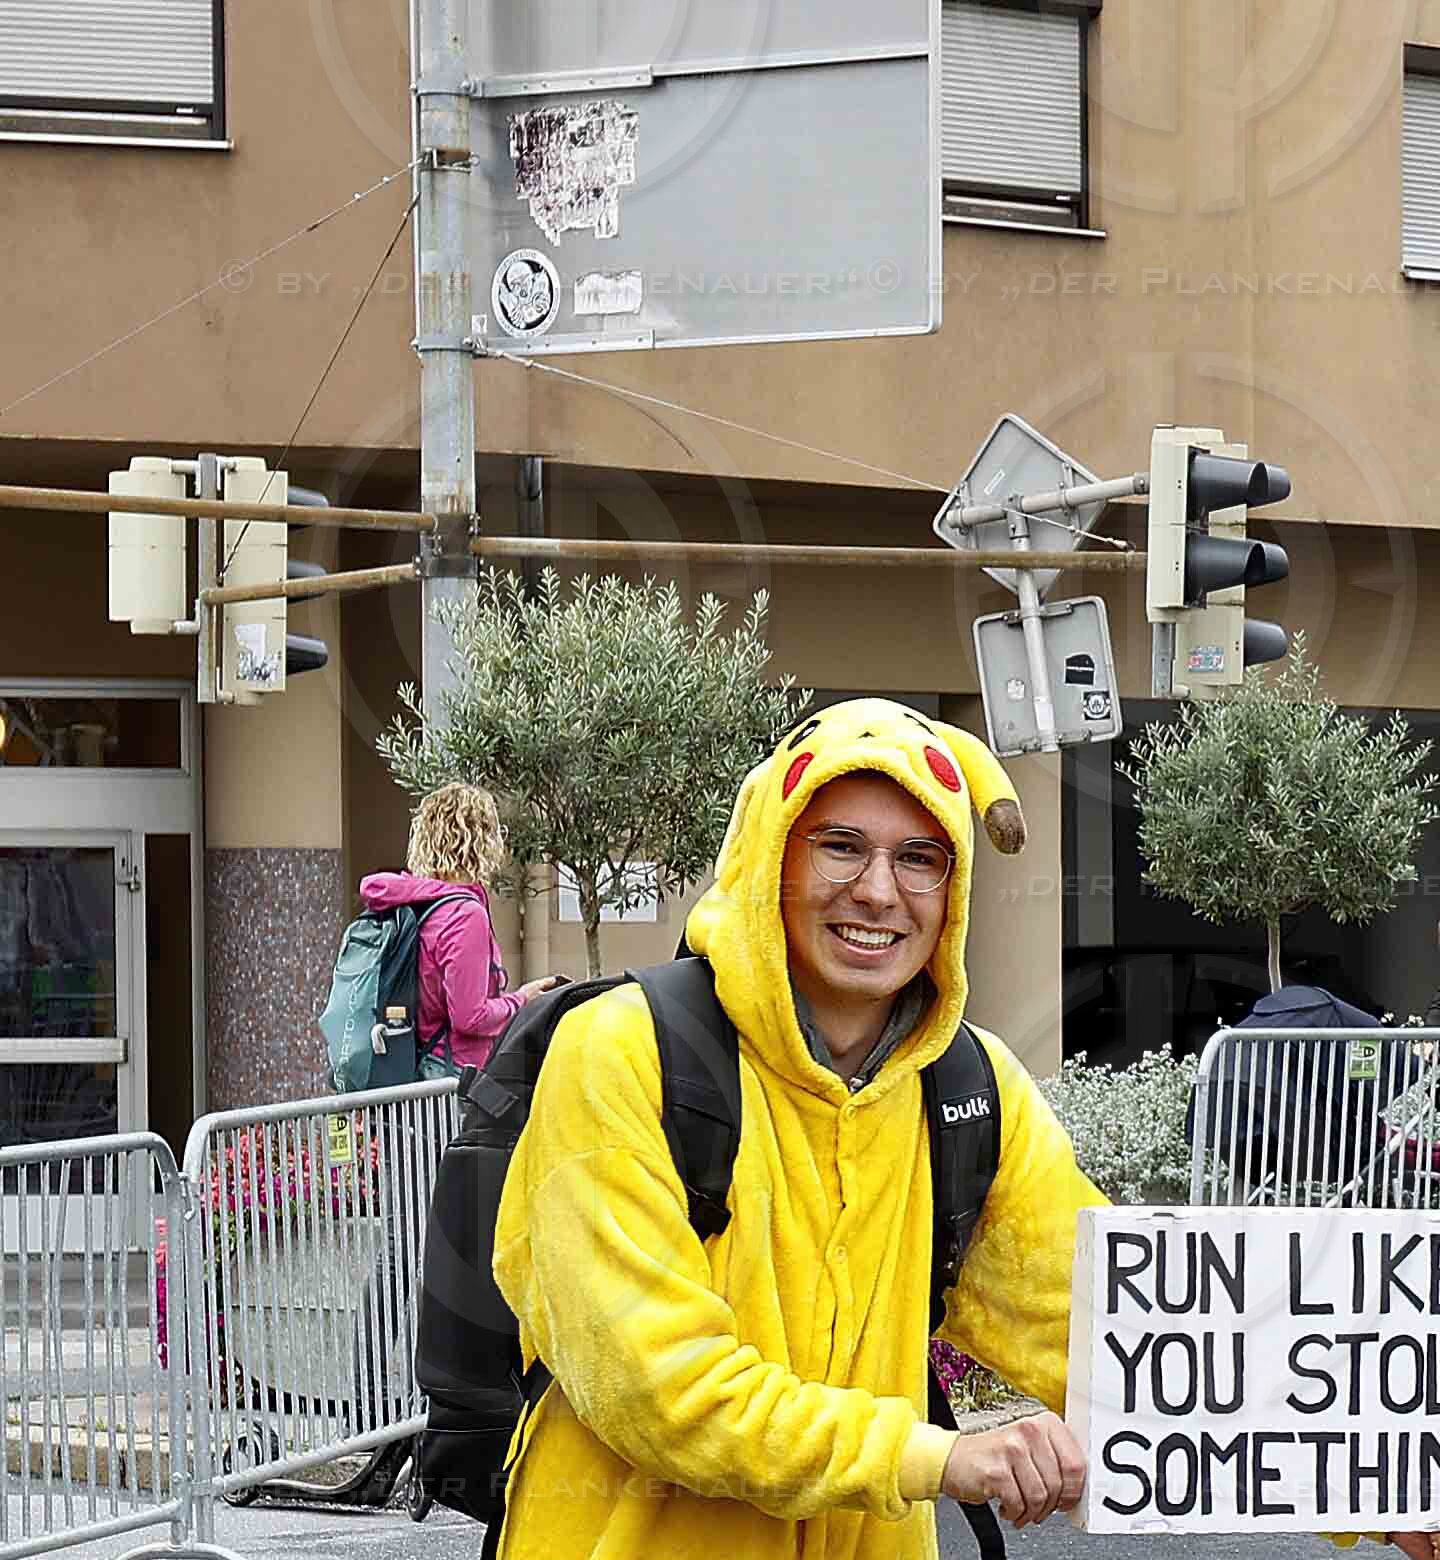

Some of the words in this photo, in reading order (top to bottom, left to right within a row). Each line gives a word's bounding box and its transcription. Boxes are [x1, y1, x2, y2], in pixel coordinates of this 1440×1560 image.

[942, 1097, 990, 1122] bulk
[1107, 1230, 1245, 1314] RUN
[1104, 1332, 1245, 1416] YOU
